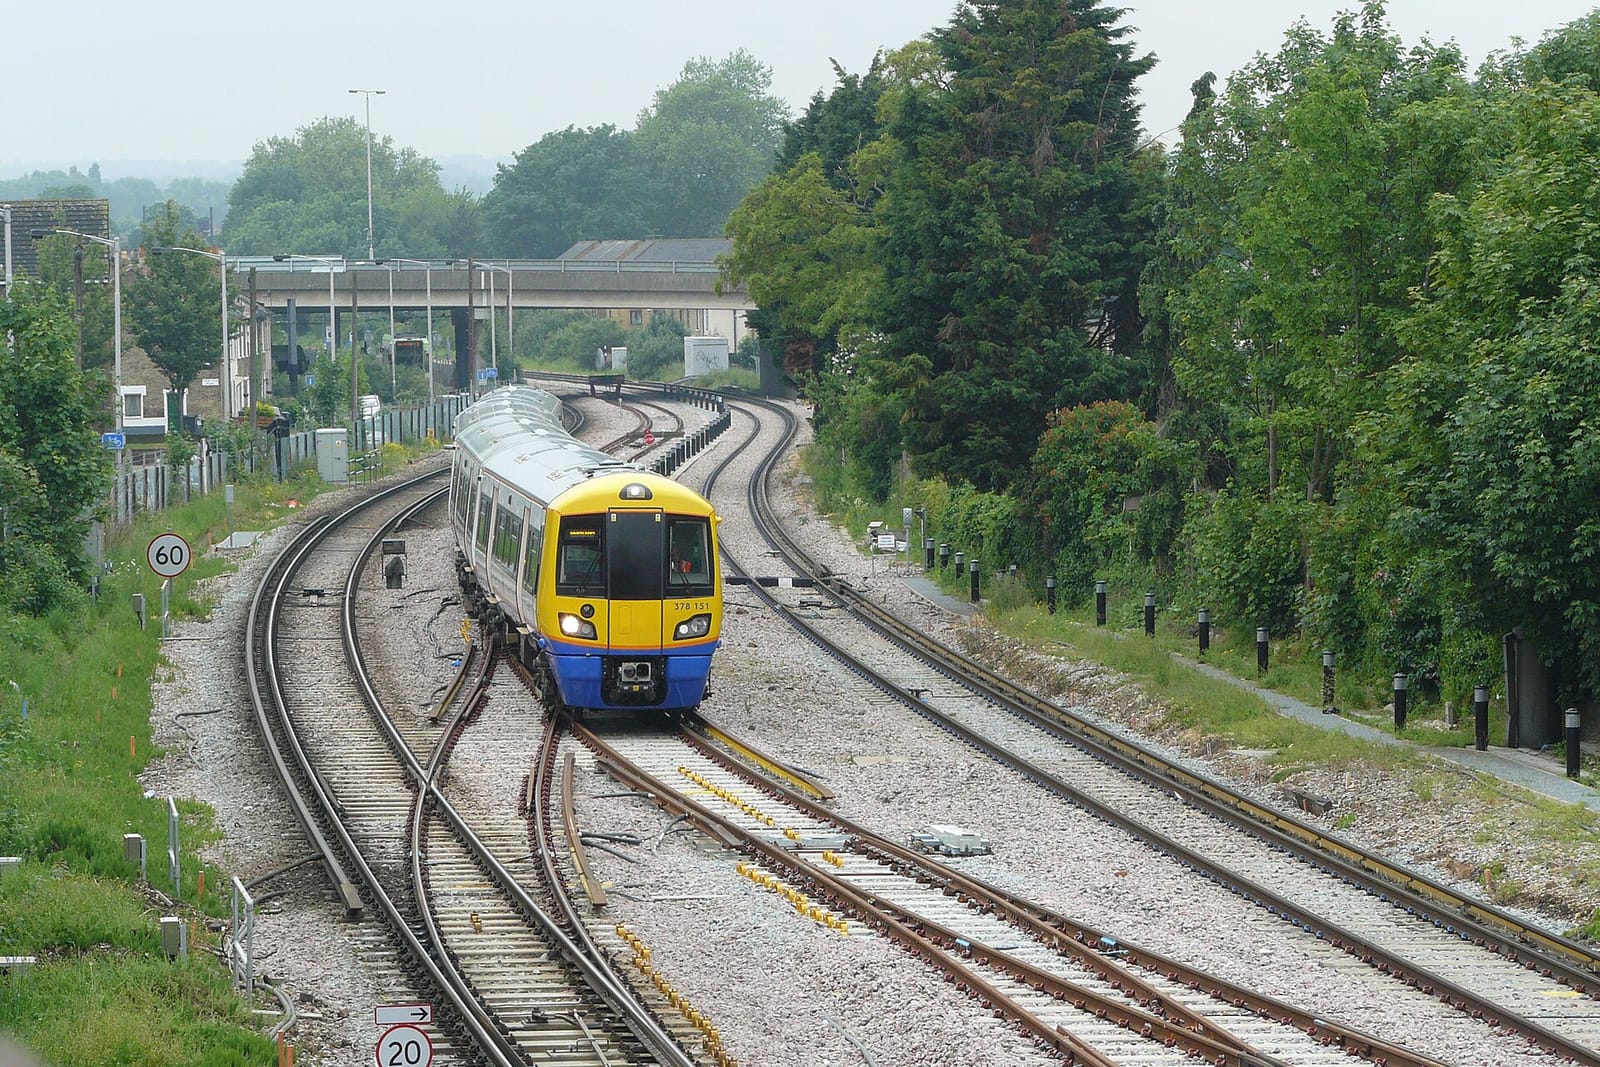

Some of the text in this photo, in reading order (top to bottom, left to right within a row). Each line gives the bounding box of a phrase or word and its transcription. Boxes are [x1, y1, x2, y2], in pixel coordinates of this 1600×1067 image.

[156, 545, 183, 566] 60
[673, 602, 709, 611] 378 151
[388, 1040, 421, 1066] 20
